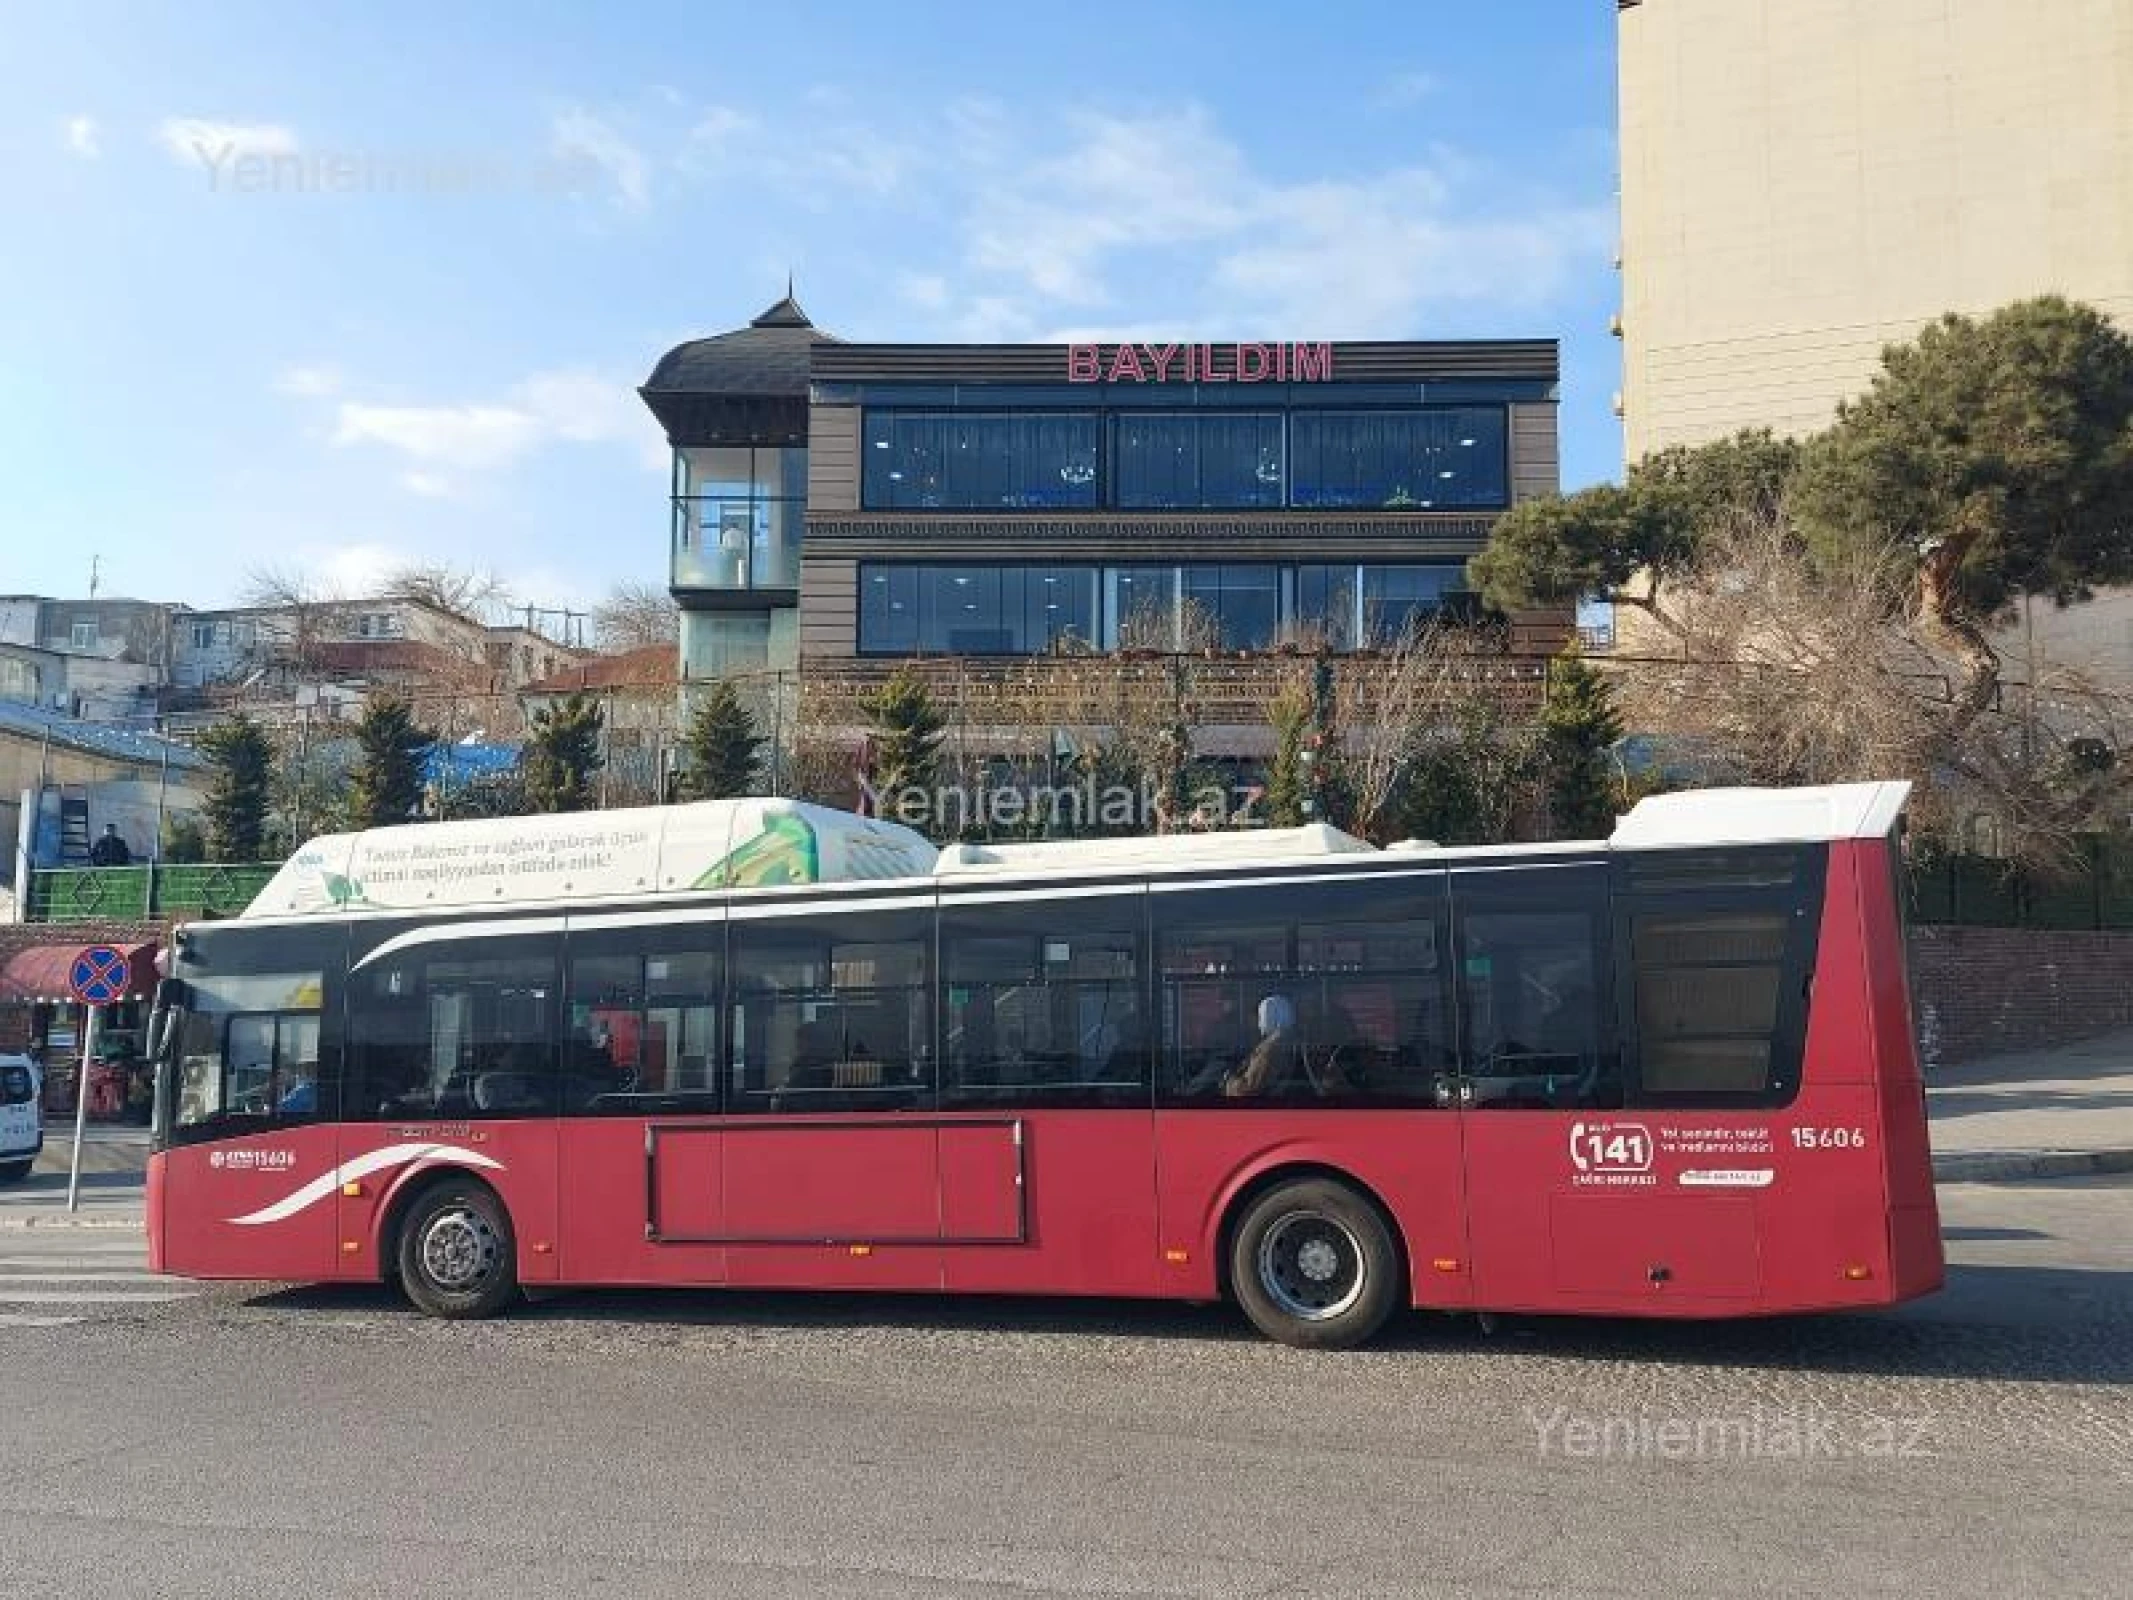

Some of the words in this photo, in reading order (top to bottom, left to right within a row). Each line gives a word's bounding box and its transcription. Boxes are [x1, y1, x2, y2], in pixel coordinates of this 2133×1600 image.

[1069, 341, 1332, 382] BAYILDIM
[1588, 1135, 1643, 1163] 141
[1791, 1127, 1865, 1148] 15606
